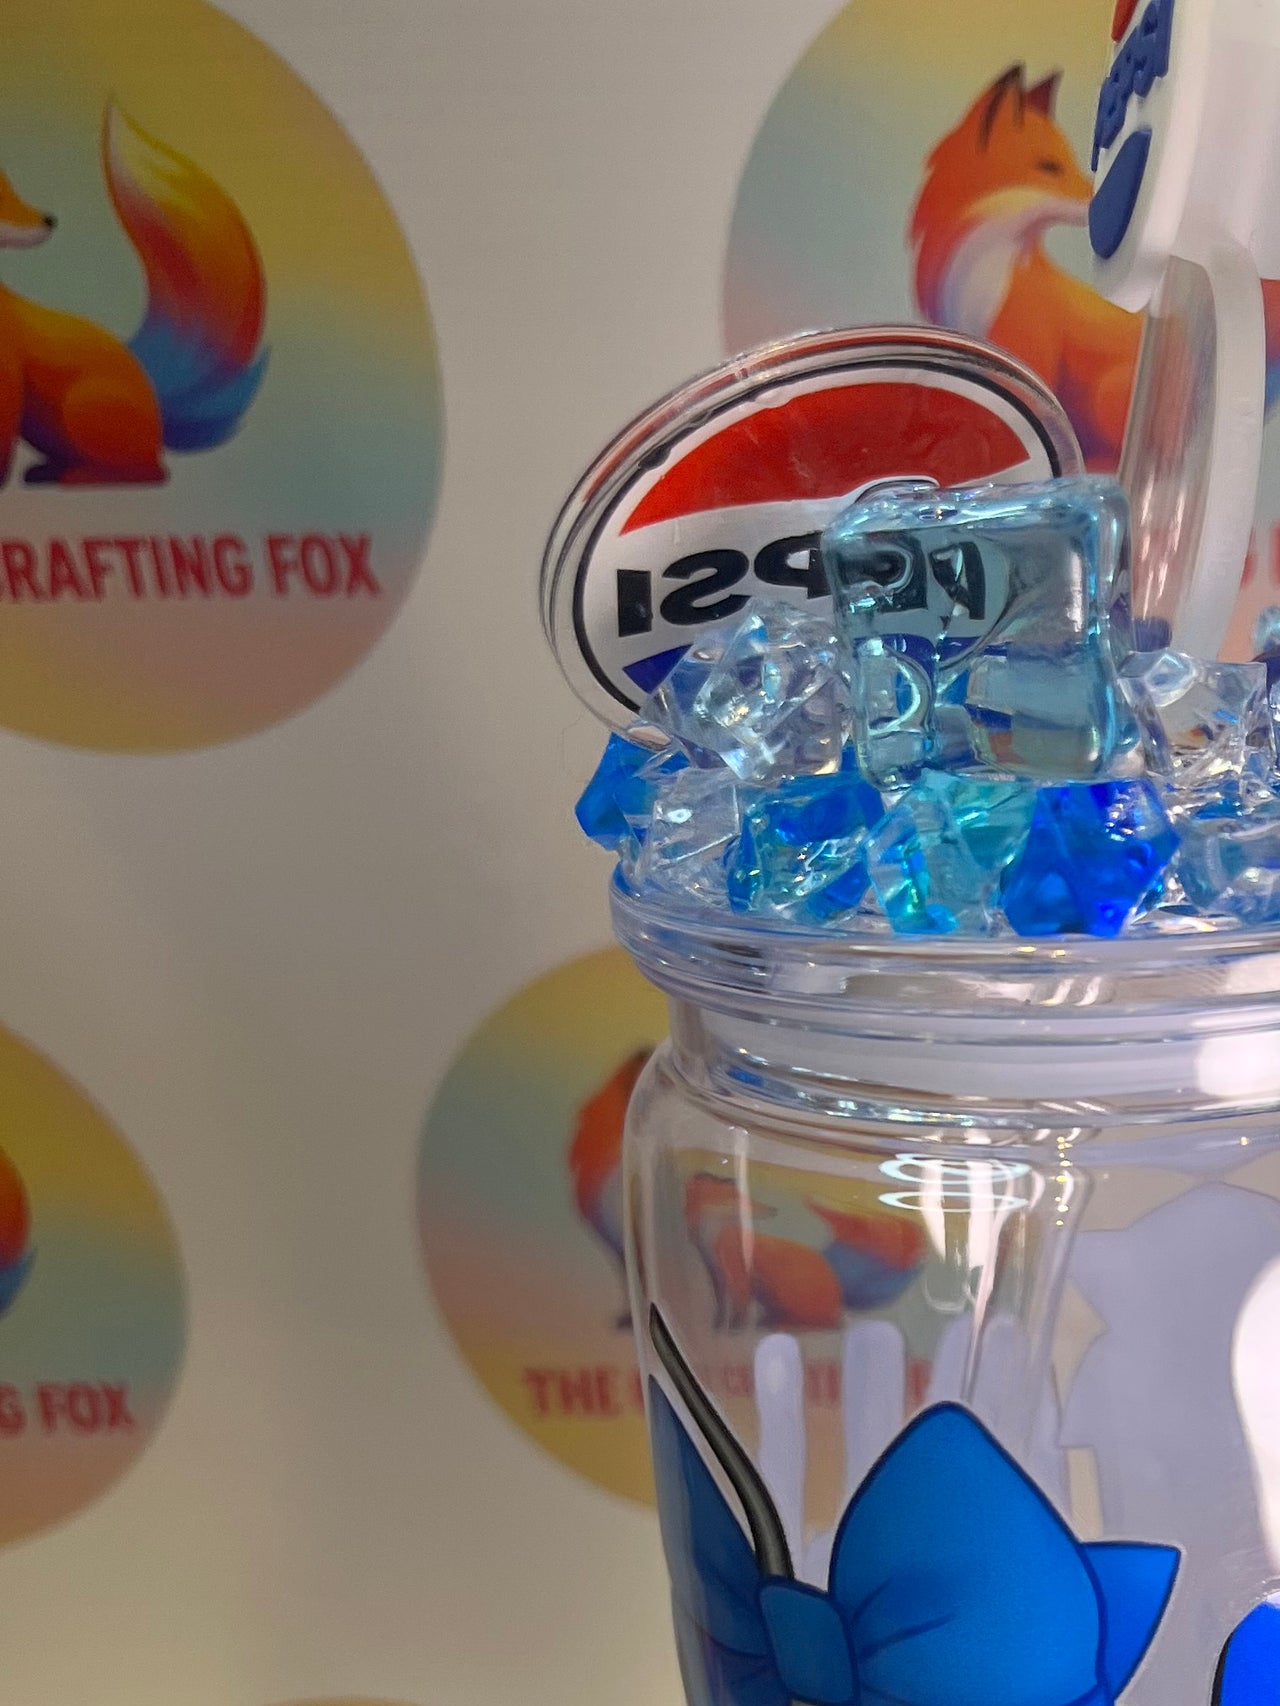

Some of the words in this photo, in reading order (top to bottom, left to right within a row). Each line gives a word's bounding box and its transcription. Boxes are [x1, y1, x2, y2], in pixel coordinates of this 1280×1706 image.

[0, 531, 254, 602] RAFTING
[266, 530, 384, 599] FOX
[35, 1379, 139, 1435] FOX
